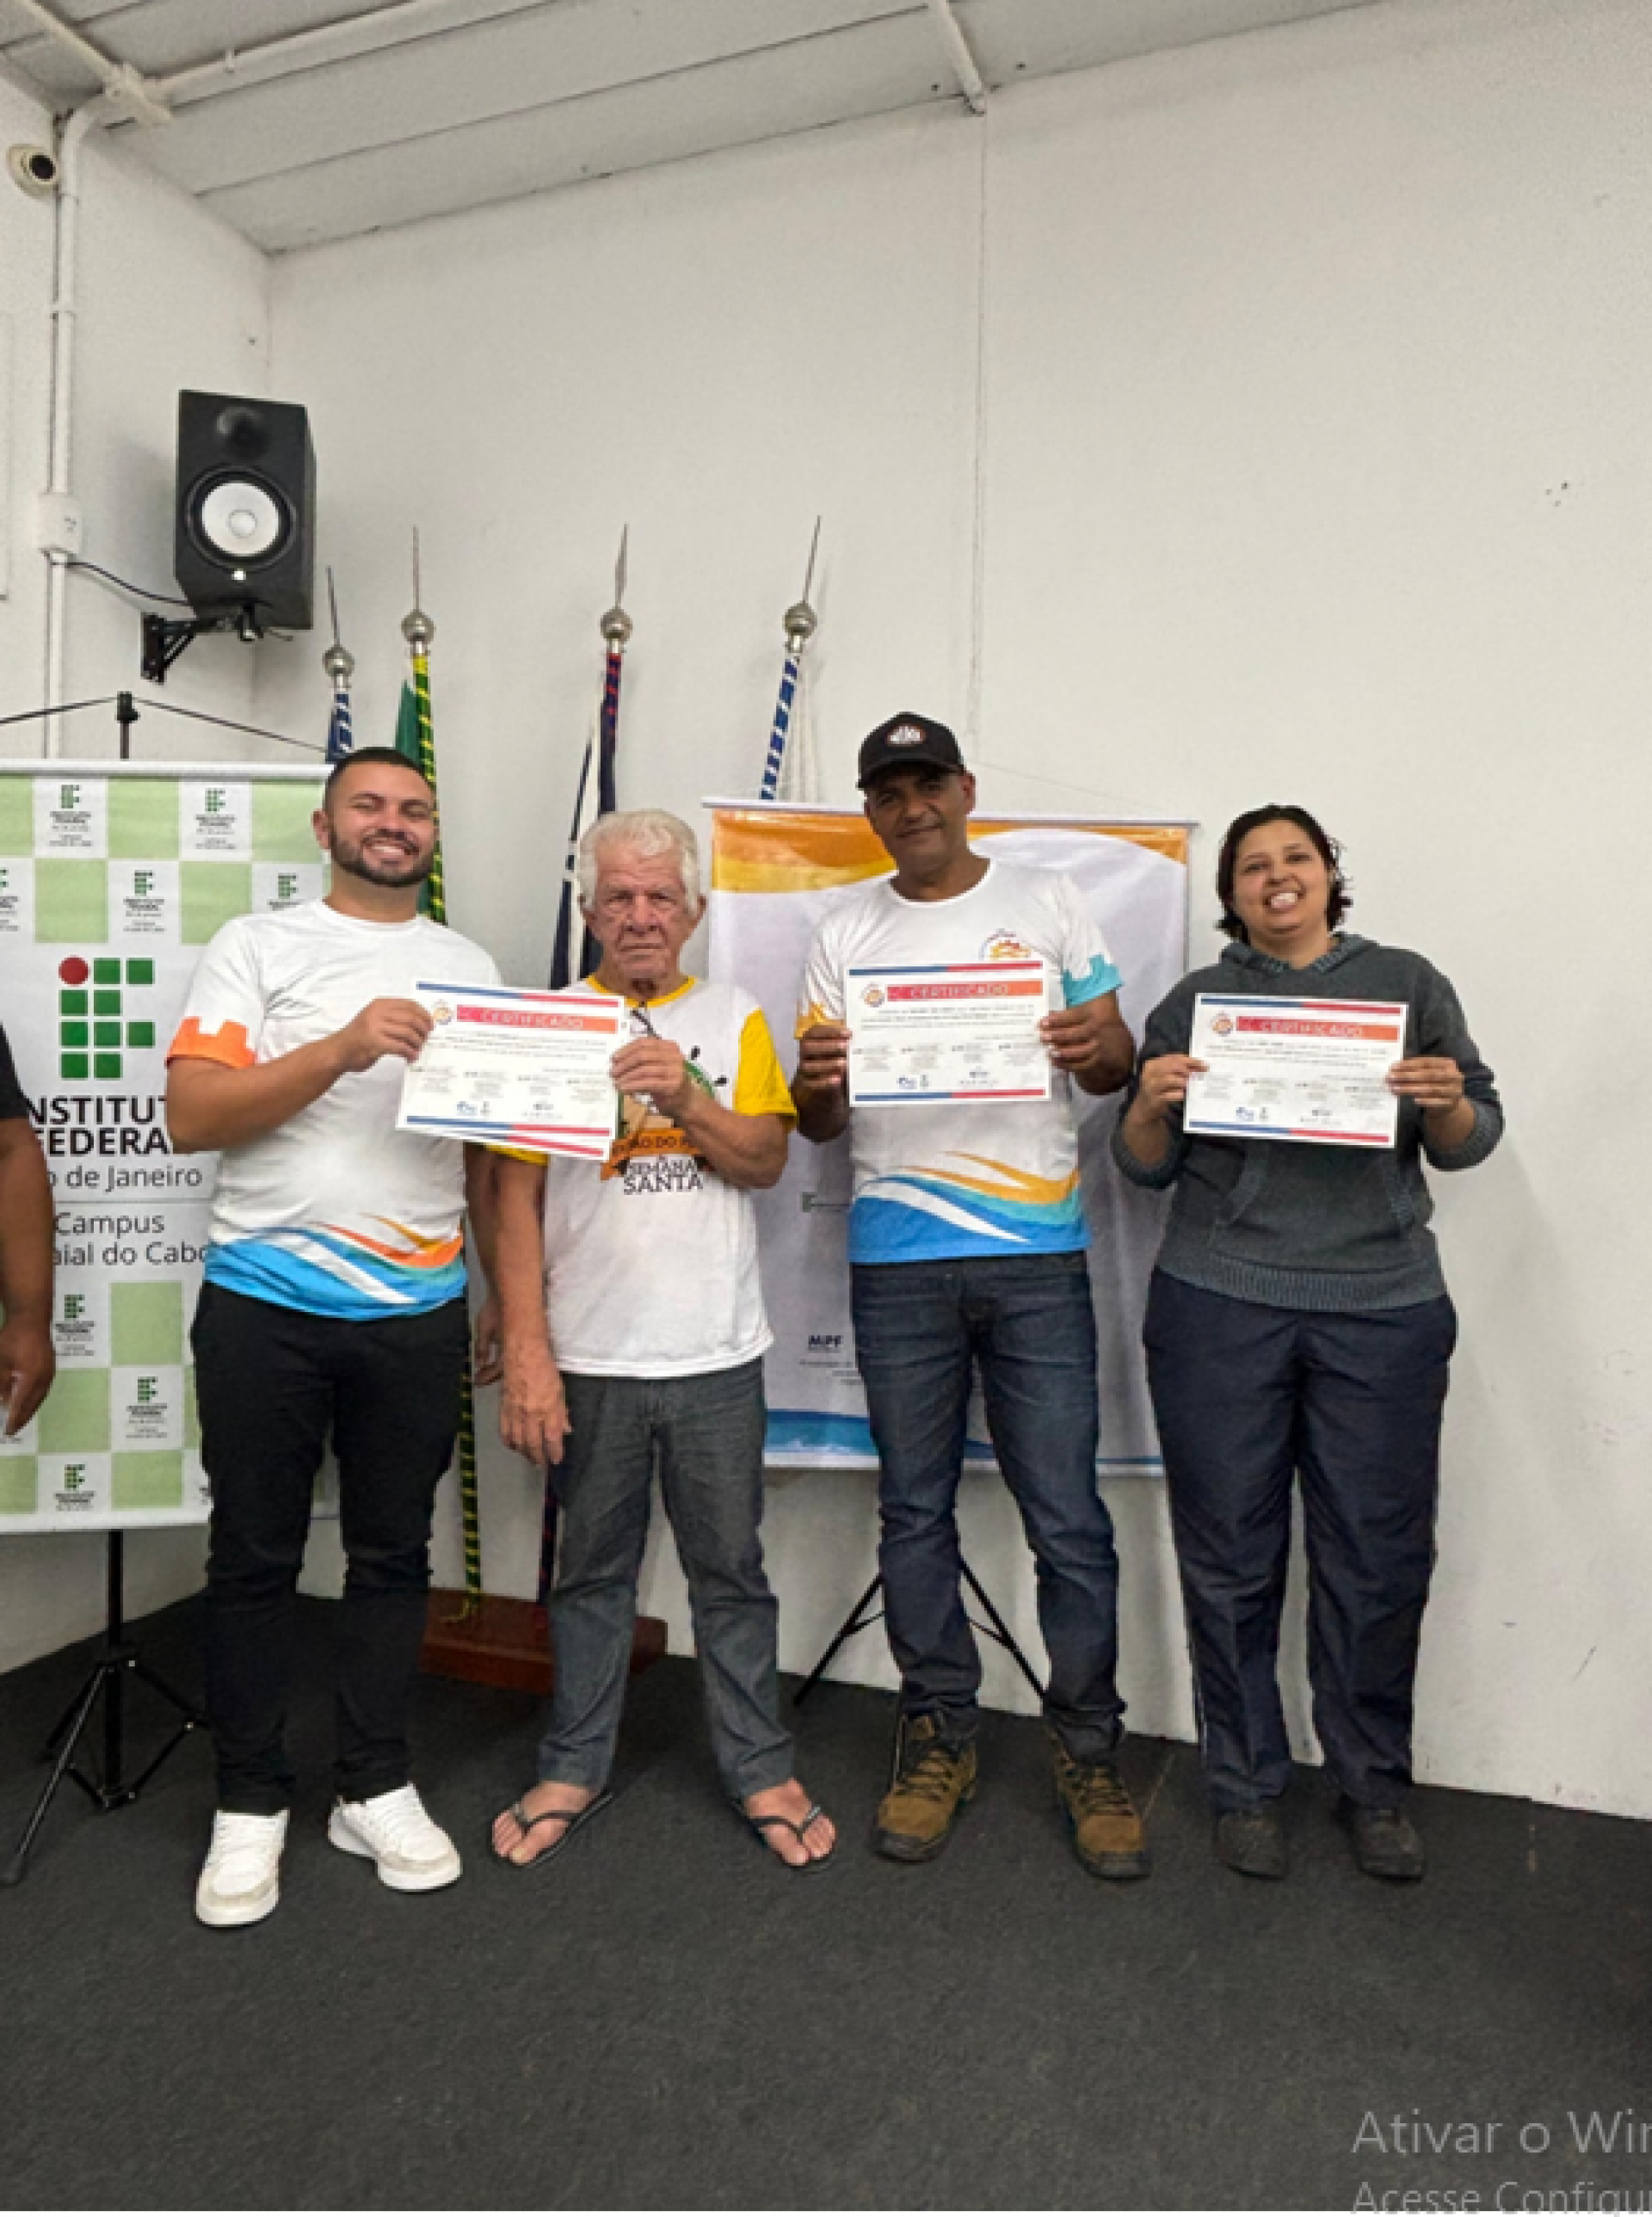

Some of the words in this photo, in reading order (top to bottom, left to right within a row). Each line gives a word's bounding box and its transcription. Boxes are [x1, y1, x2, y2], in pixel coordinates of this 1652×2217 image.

[910, 983, 1008, 1000] CERTIFICADO
[483, 1010, 583, 1029] CERTIFICADO
[1261, 1019, 1364, 1038] CERTIFICADO
[29, 1097, 167, 1124] NSTITU
[35, 1128, 170, 1155] EDERA
[66, 1165, 100, 1187] de
[105, 1164, 203, 1192] Janeiro
[624, 1173, 703, 1195] SANTA
[54, 1212, 165, 1239] Campus
[102, 1242, 138, 1266] do
